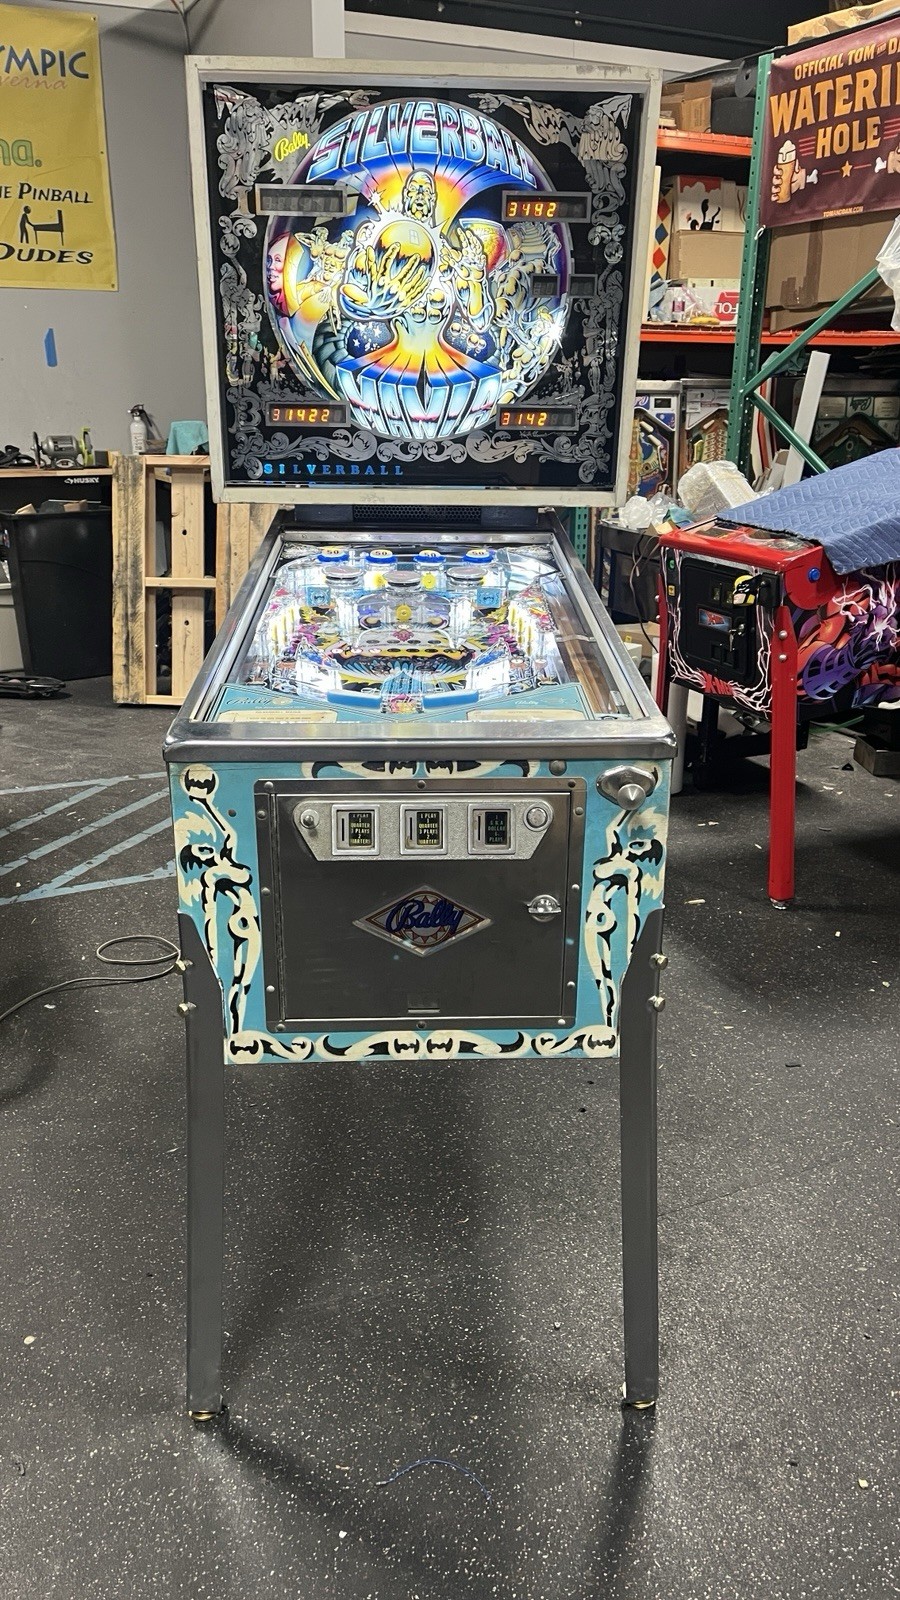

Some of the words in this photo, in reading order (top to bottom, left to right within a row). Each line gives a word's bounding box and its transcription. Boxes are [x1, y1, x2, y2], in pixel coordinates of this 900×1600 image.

[794, 52, 844, 81] OFFICIAL
[847, 43, 875, 66] TOM
[274, 131, 311, 162] Bally
[306, 100, 538, 189] SILVERBALL
[815, 116, 881, 159] HOLE
[19, 182, 94, 204] PINBALL
[0, 242, 94, 264] DUDES
[336, 366, 501, 440] MANIA
[263, 463, 404, 476] SILVERBALL
[385, 900, 465, 934] Bally
